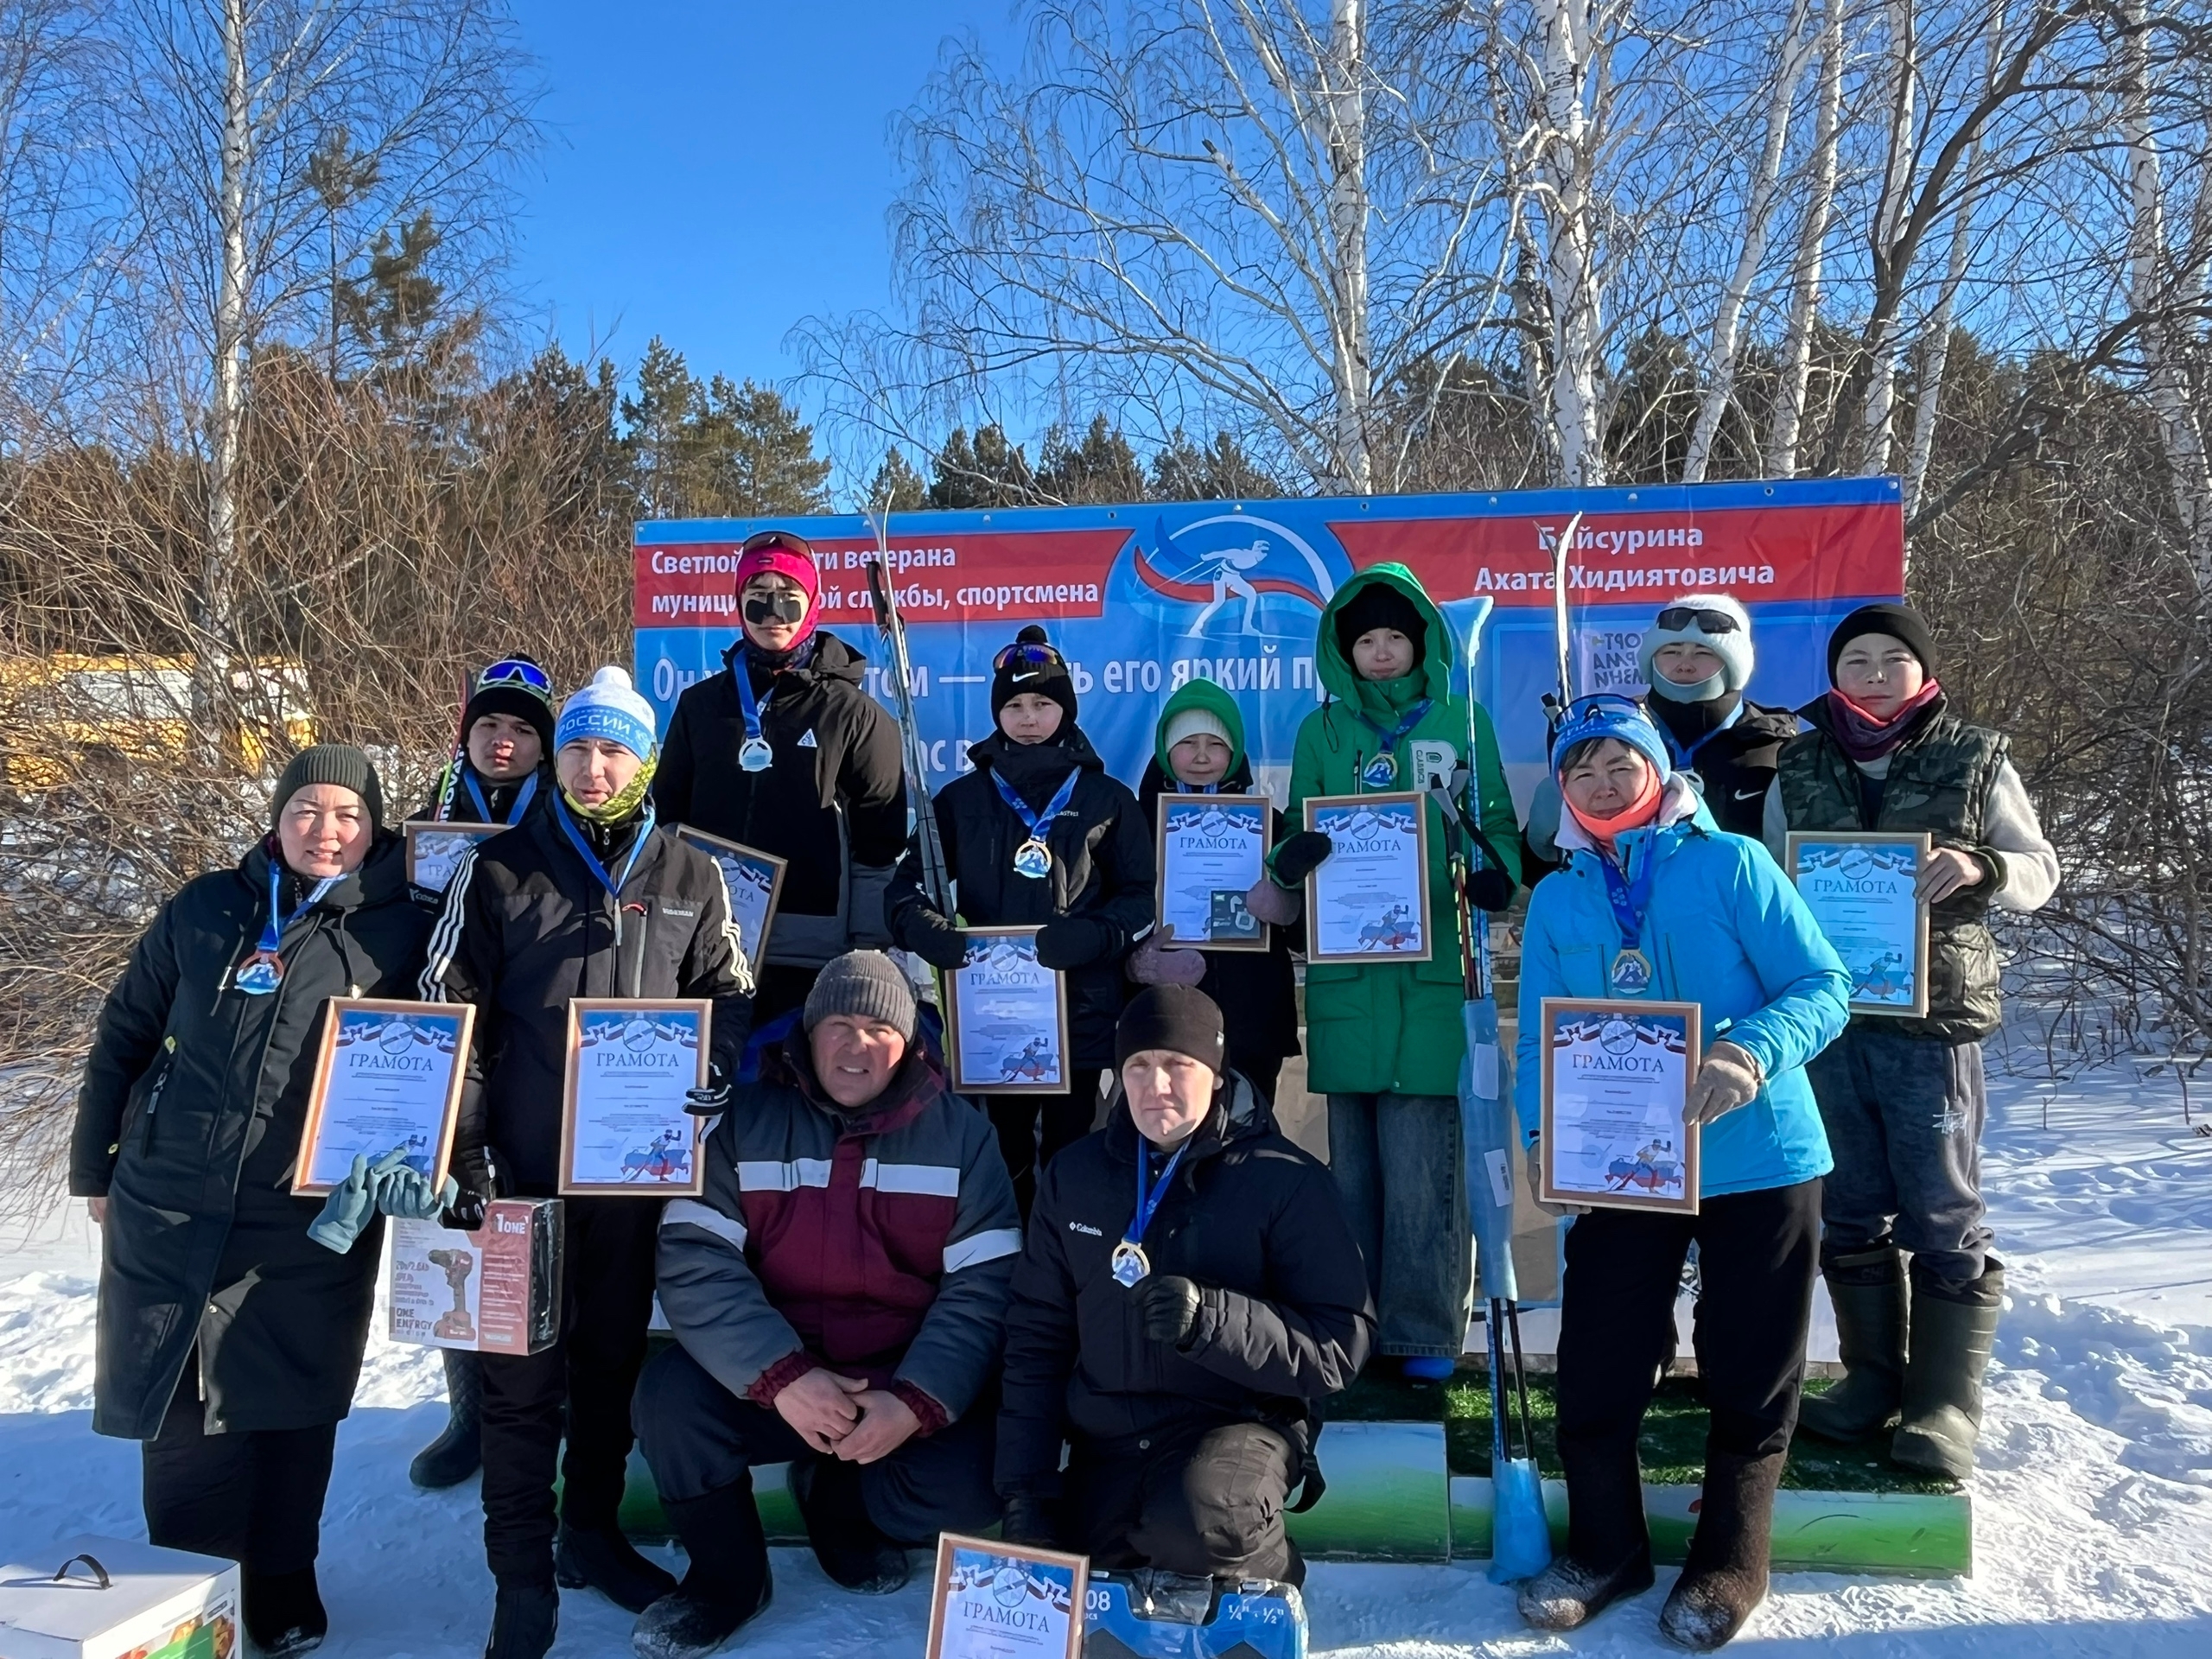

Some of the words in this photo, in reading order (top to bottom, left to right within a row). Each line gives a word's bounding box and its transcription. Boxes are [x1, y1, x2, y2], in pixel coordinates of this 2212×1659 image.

[1474, 567, 1557, 592] Ахата
[1567, 564, 1776, 593] Хидиятовича
[848, 582, 950, 611] слжбы,
[957, 583, 1098, 611] спортсмена
[1103, 659, 1162, 693] его
[1170, 645, 1281, 692] яркий
[1179, 836, 1248, 849] ГРАМОТА
[1813, 879, 1898, 894] ГРАМОТА
[969, 972, 1040, 986] ГРАМОТА
[349, 1053, 434, 1071] ГРАМОТА
[596, 1052, 679, 1067] ГРАМОТА
[1572, 1053, 1665, 1073] ГРАМОТА
[963, 1600, 1051, 1633] ГРАМОТА
